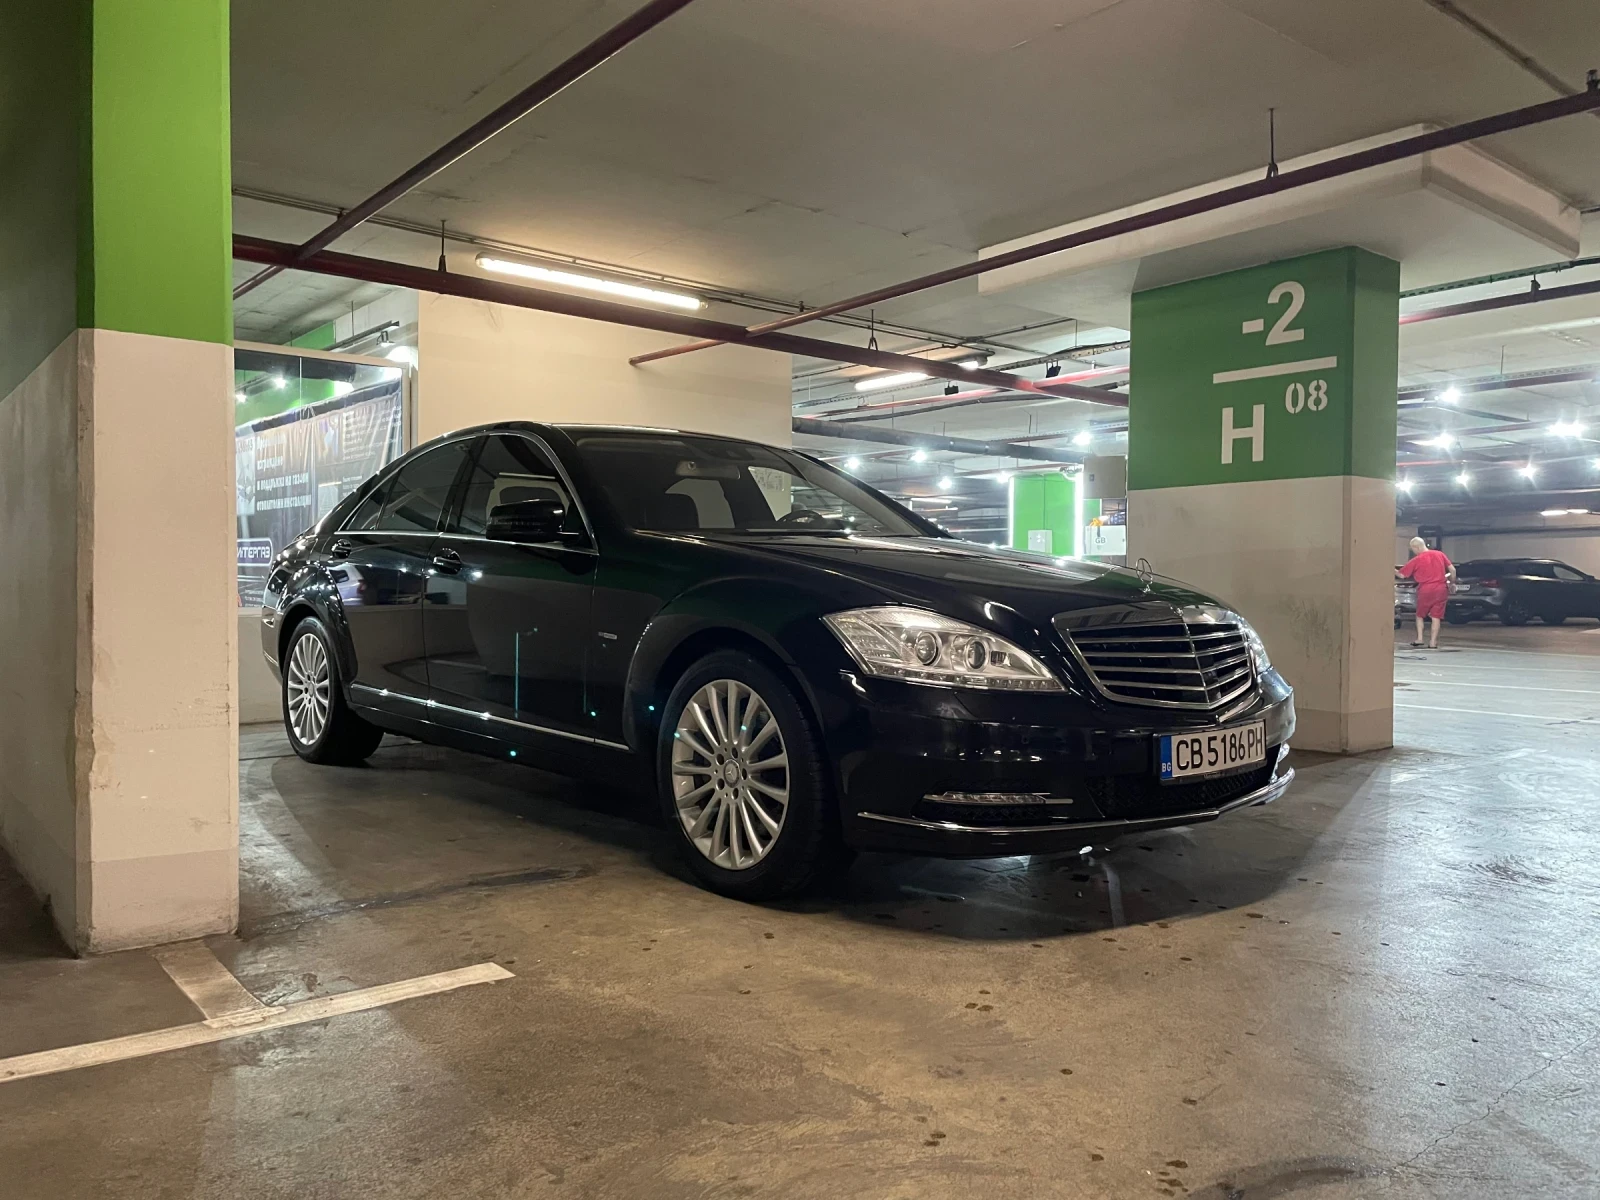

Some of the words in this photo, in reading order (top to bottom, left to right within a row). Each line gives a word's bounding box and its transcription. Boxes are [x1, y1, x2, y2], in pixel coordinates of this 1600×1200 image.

[1242, 280, 1306, 346] -2
[1220, 403, 1265, 465] H
[1284, 379, 1329, 414] 08
[1161, 762, 1172, 773] BG
